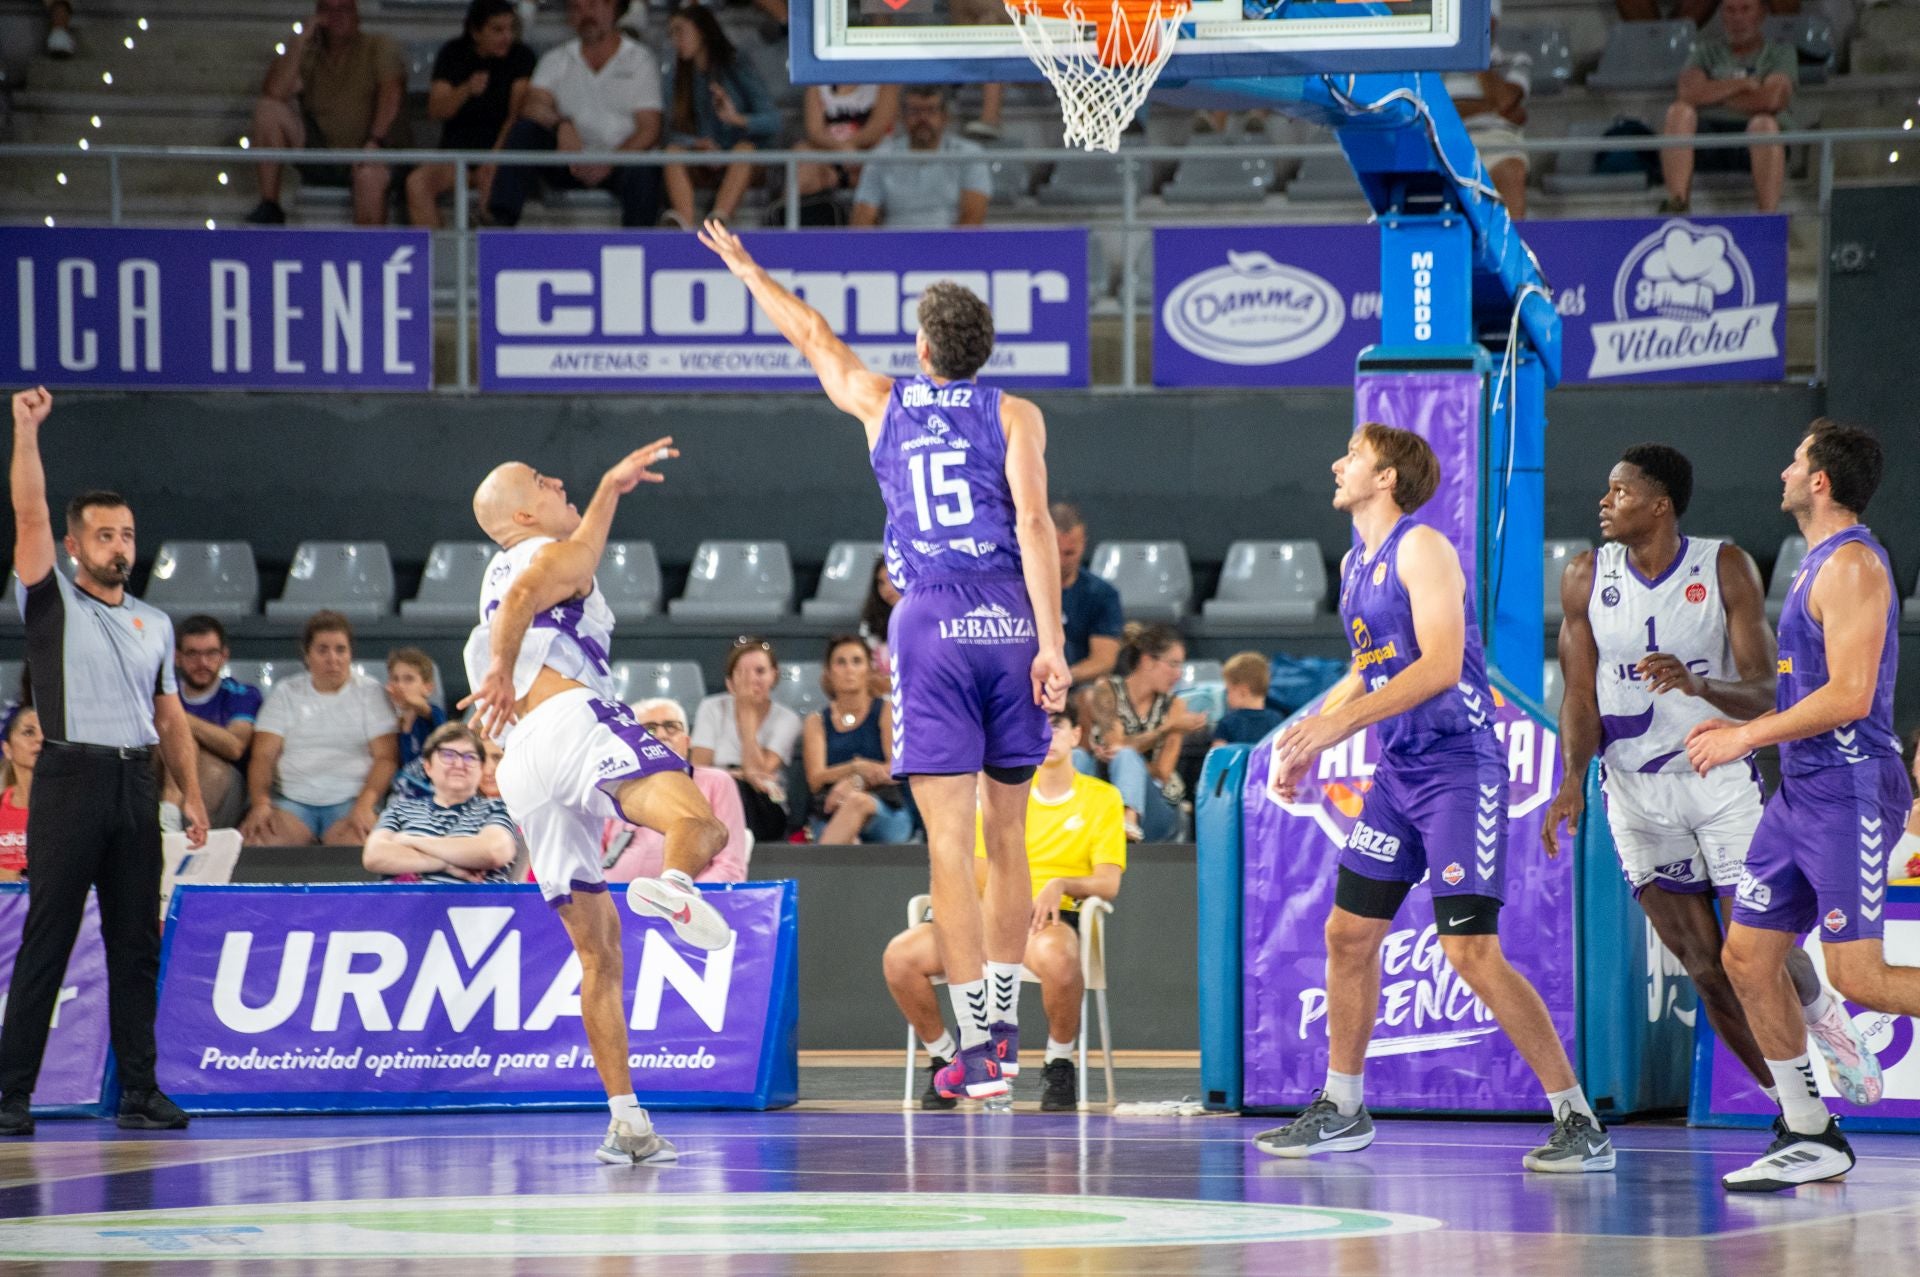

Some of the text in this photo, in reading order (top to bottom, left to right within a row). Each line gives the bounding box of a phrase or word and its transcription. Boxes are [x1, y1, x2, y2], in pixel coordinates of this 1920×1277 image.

[210, 246, 417, 375] RENÉ
[1411, 251, 1434, 341] MONDO
[1609, 316, 1760, 364] Vitalchef
[550, 353, 649, 371] ANTENAS
[908, 451, 975, 532] 15
[1644, 616, 1659, 652] 1
[1861, 1013, 1891, 1041] rupo
[200, 1045, 716, 1077] Productividad optimizada para el manizado
